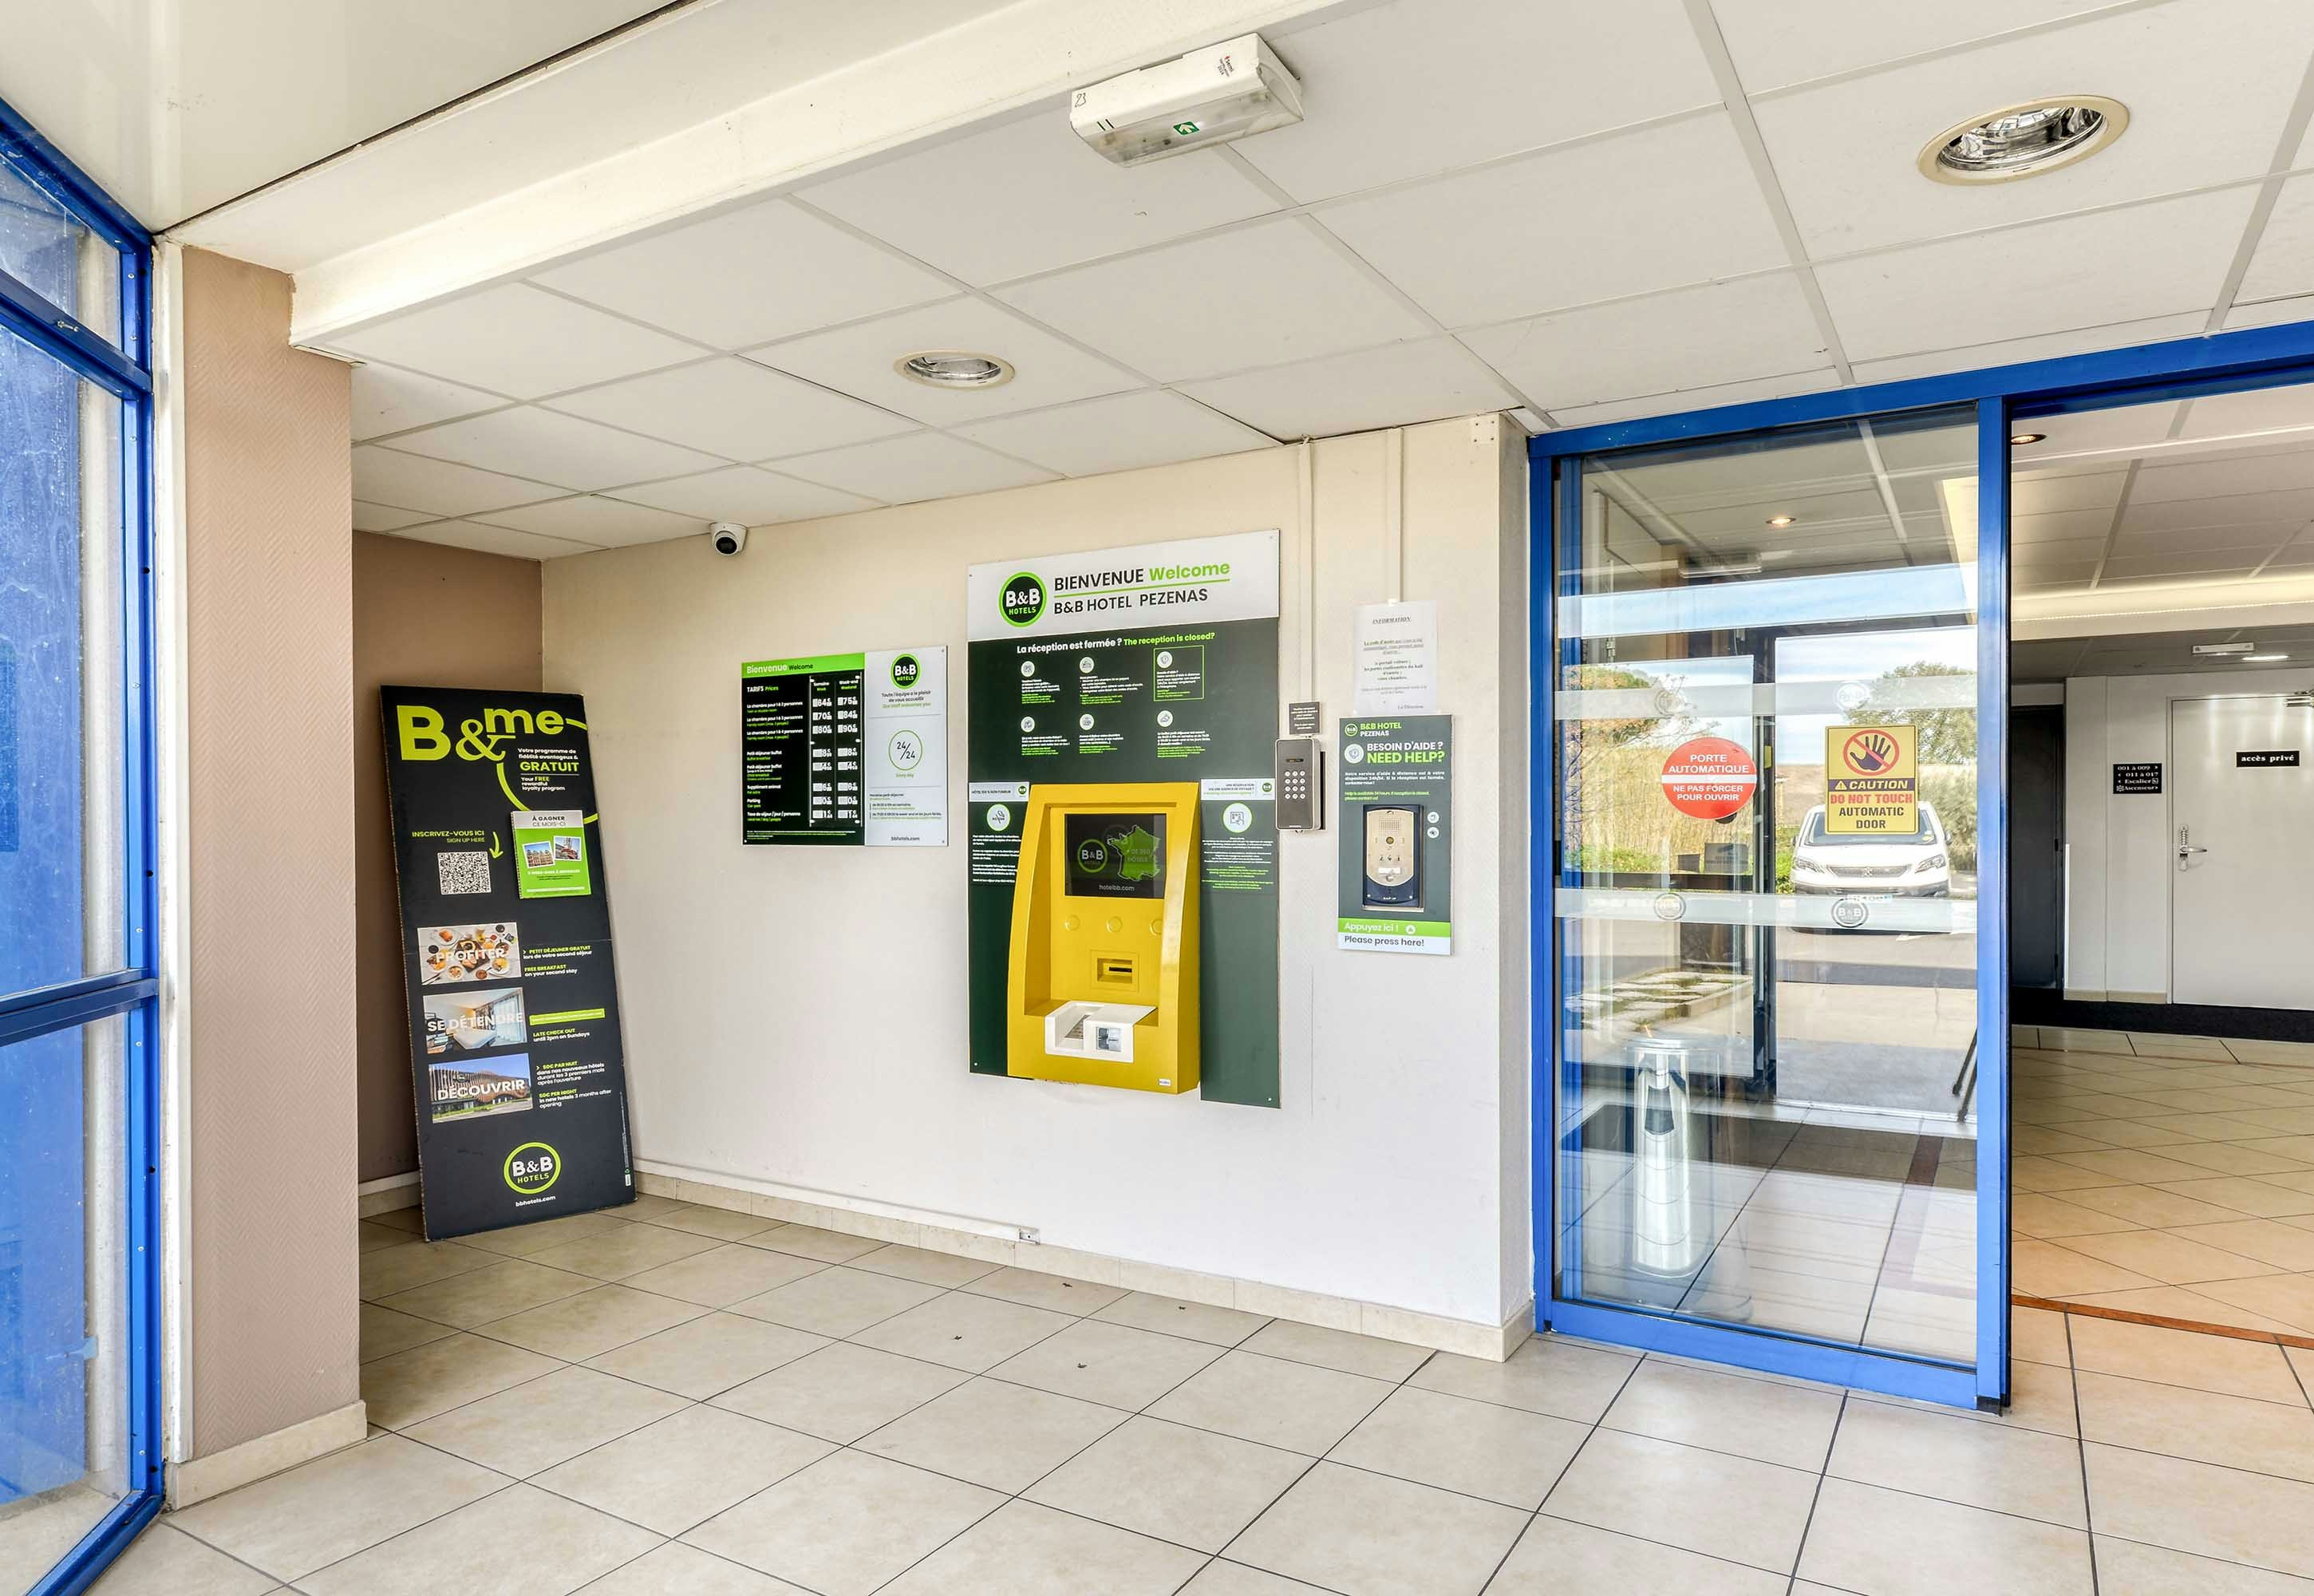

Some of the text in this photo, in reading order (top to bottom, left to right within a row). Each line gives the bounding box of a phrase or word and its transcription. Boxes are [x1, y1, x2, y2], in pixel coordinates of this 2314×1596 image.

[1055, 563, 1230, 591] BIENVENUE Welcome
[1005, 588, 1040, 607] B&B
[1055, 588, 1207, 614] B&B HOTEL PEZENAS
[1009, 606, 1036, 615] HOTELS
[1028, 642, 1068, 654] réception
[1084, 639, 1116, 649] fermée
[1139, 636, 1175, 646] reception
[1184, 632, 1215, 641] closed?
[747, 665, 787, 674] Bienvenue
[894, 664, 916, 676] B&B
[1404, 741, 1435, 750] D'AIDE
[1367, 751, 1445, 763] NEED HELP?
[520, 761, 578, 772] GRATUIT
[1850, 780, 1908, 789] CAUTION
[1830, 794, 1912, 804] DO NOT TOUCH
[1839, 807, 1904, 816] AUTOMATIC
[1856, 820, 1886, 828] DOOR
[1082, 850, 1104, 859] B&B
[1345, 922, 1381, 932] Appuyez
[436, 948, 505, 962] PROFITER
[428, 1021, 446, 1032] SE
[449, 1013, 523, 1029] DÉTENDRE
[437, 1080, 525, 1100] DÉCOUVRIR
[512, 1156, 553, 1176] B&B
[518, 1173, 550, 1183] HOTELS
[515, 1195, 555, 1207] bbhotels.com
